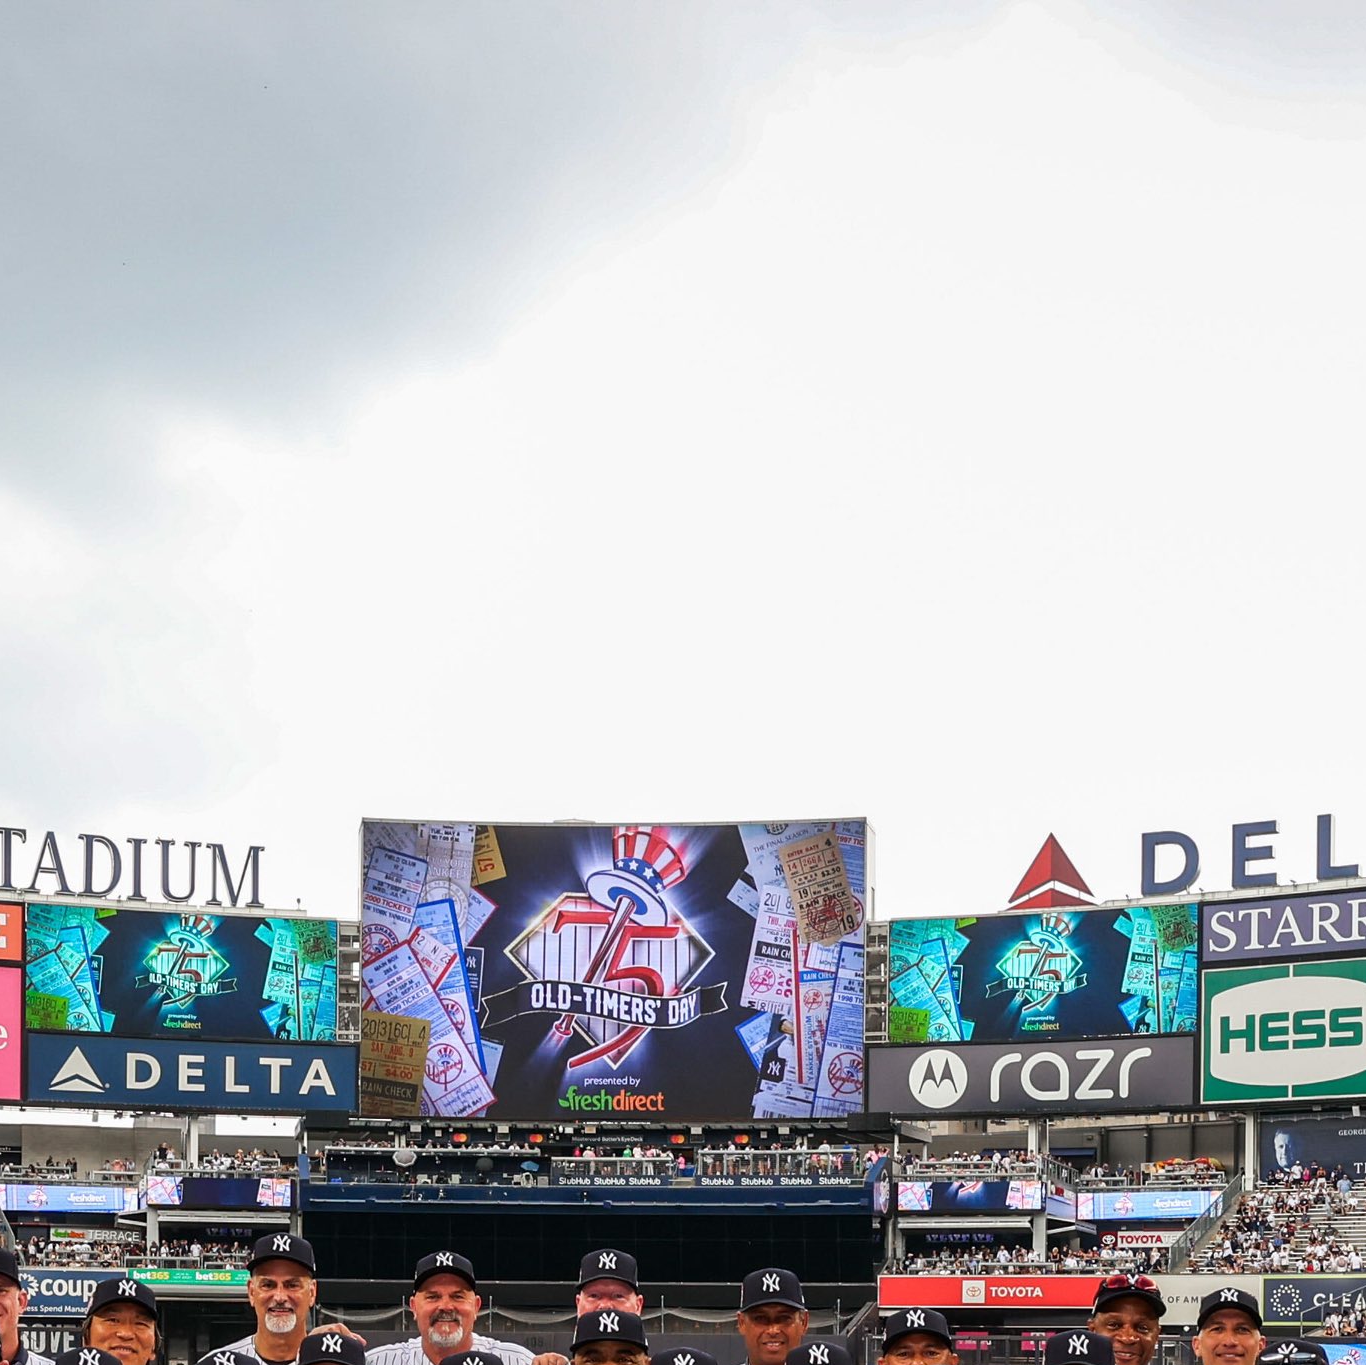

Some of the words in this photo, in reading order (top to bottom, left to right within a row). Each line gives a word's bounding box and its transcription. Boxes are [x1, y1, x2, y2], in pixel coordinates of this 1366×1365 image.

[761, 945, 778, 956] RAIN
[201, 980, 219, 994] DAY
[530, 983, 662, 1025] OLD-TIMERS'
[668, 994, 697, 1025] DAY
[165, 1018, 202, 1031] freshdirect
[1024, 1021, 1060, 1033] freshdirect
[1219, 1007, 1363, 1054] HESS
[126, 1052, 337, 1096] DELTA
[385, 1069, 413, 1080] $4.00
[990, 1047, 1152, 1102] razr
[584, 1077, 628, 1088] presented
[630, 1077, 641, 1088] by
[362, 1081, 384, 1095] RAIN
[385, 1083, 413, 1098] CHECK
[565, 1085, 665, 1111] freshdirect
[1338, 1128, 1366, 1137] GEORGE
[559, 1177, 591, 1187] StubHub
[594, 1177, 626, 1187] StubHub
[629, 1177, 661, 1187] StubHub
[701, 1177, 734, 1187] StubHub
[741, 1177, 773, 1187] StubHub
[780, 1177, 812, 1186] StubHub
[819, 1176, 851, 1186] StubHub
[69, 1192, 107, 1204] freshdirect
[1156, 1198, 1193, 1209] freshdirect
[88, 1229, 141, 1242] TERRACE
[1118, 1235, 1163, 1244] TOYOTA
[435, 1251, 454, 1267] NY
[598, 1252, 618, 1270] NY
[133, 1270, 170, 1281] bet365
[195, 1271, 231, 1281] bet365
[989, 1286, 1043, 1298] TOYOTA
[1168, 1295, 1182, 1304] OF
[39, 1305, 63, 1315] Spend
[1067, 1334, 1090, 1355] NY
[808, 1342, 830, 1365] NY
